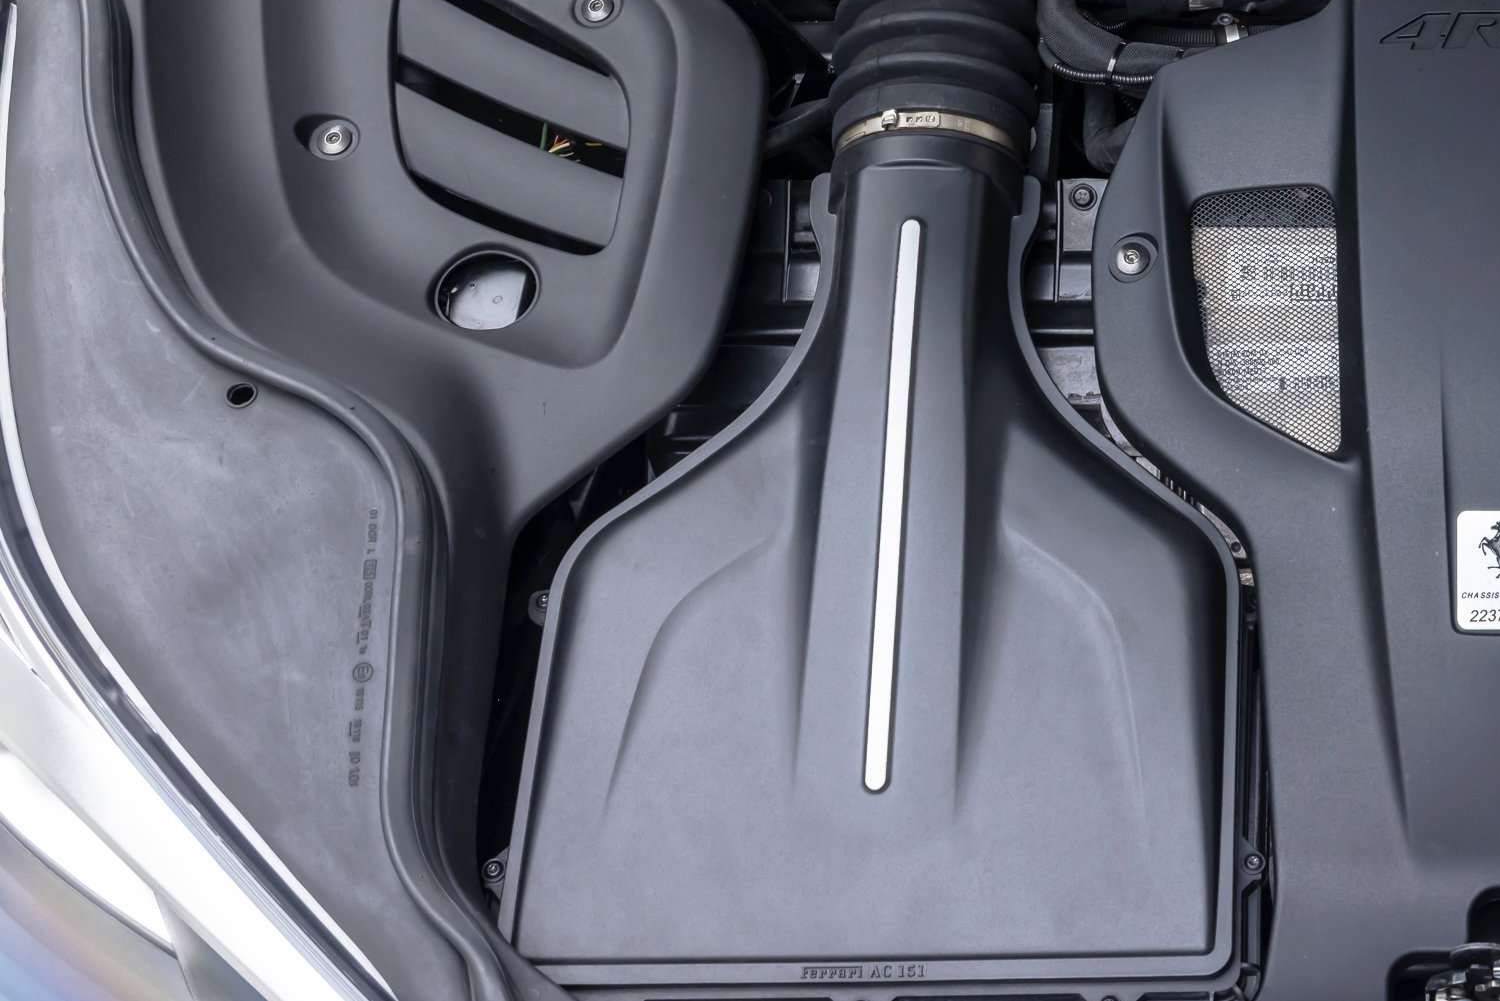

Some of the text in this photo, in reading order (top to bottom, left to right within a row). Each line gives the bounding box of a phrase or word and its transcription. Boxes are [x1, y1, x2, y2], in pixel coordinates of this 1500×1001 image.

[800, 964, 926, 979] Ferrari AC 151
